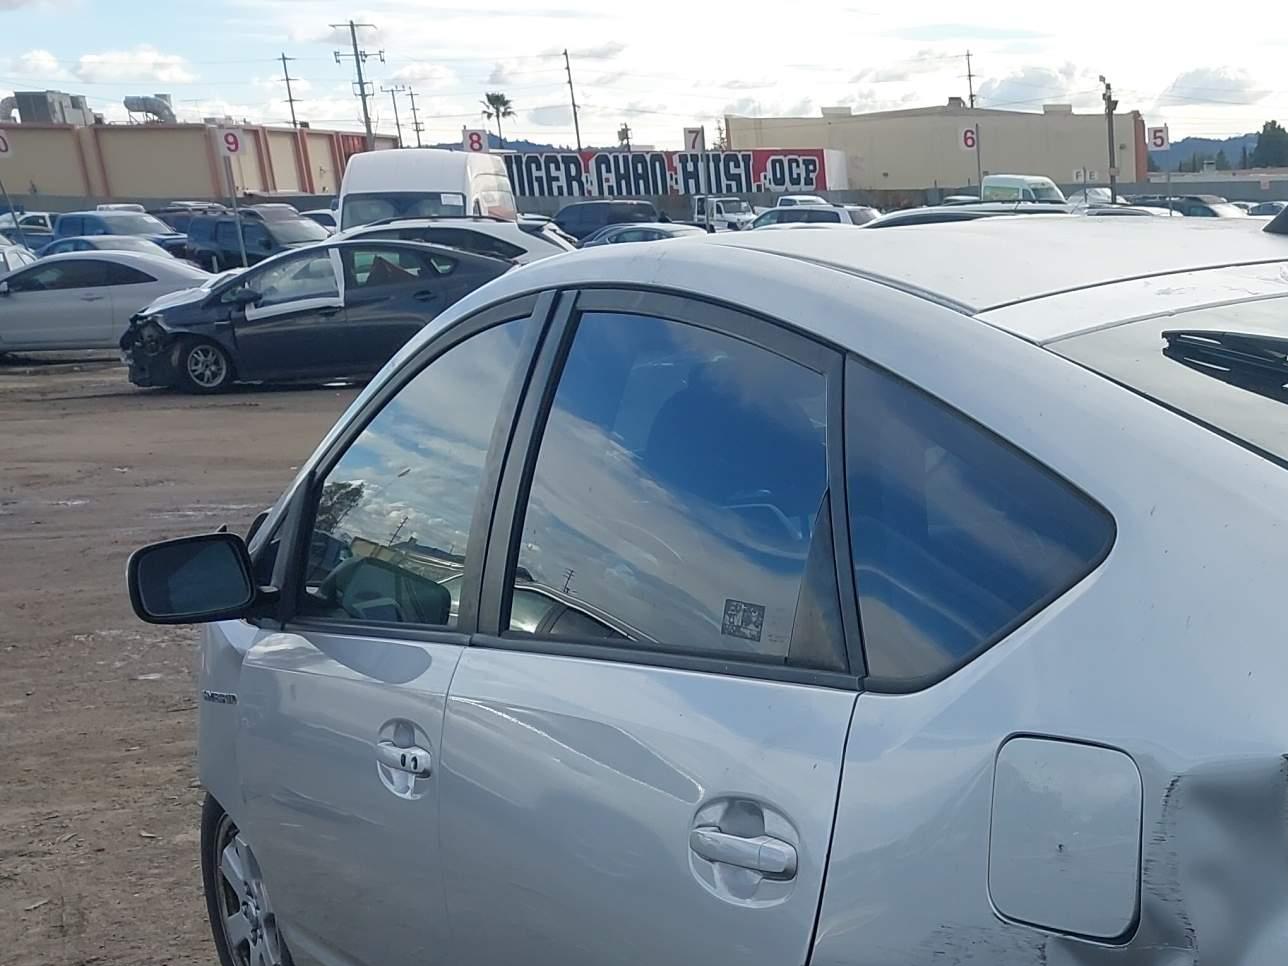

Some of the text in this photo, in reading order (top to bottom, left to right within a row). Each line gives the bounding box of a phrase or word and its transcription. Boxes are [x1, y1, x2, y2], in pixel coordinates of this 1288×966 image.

[223, 132, 239, 153] 9
[468, 132, 483, 152] 8
[687, 129, 701, 150] 7
[963, 129, 976, 148] 6
[1152, 129, 1165, 147] 5
[771, 156, 821, 191] OCP
